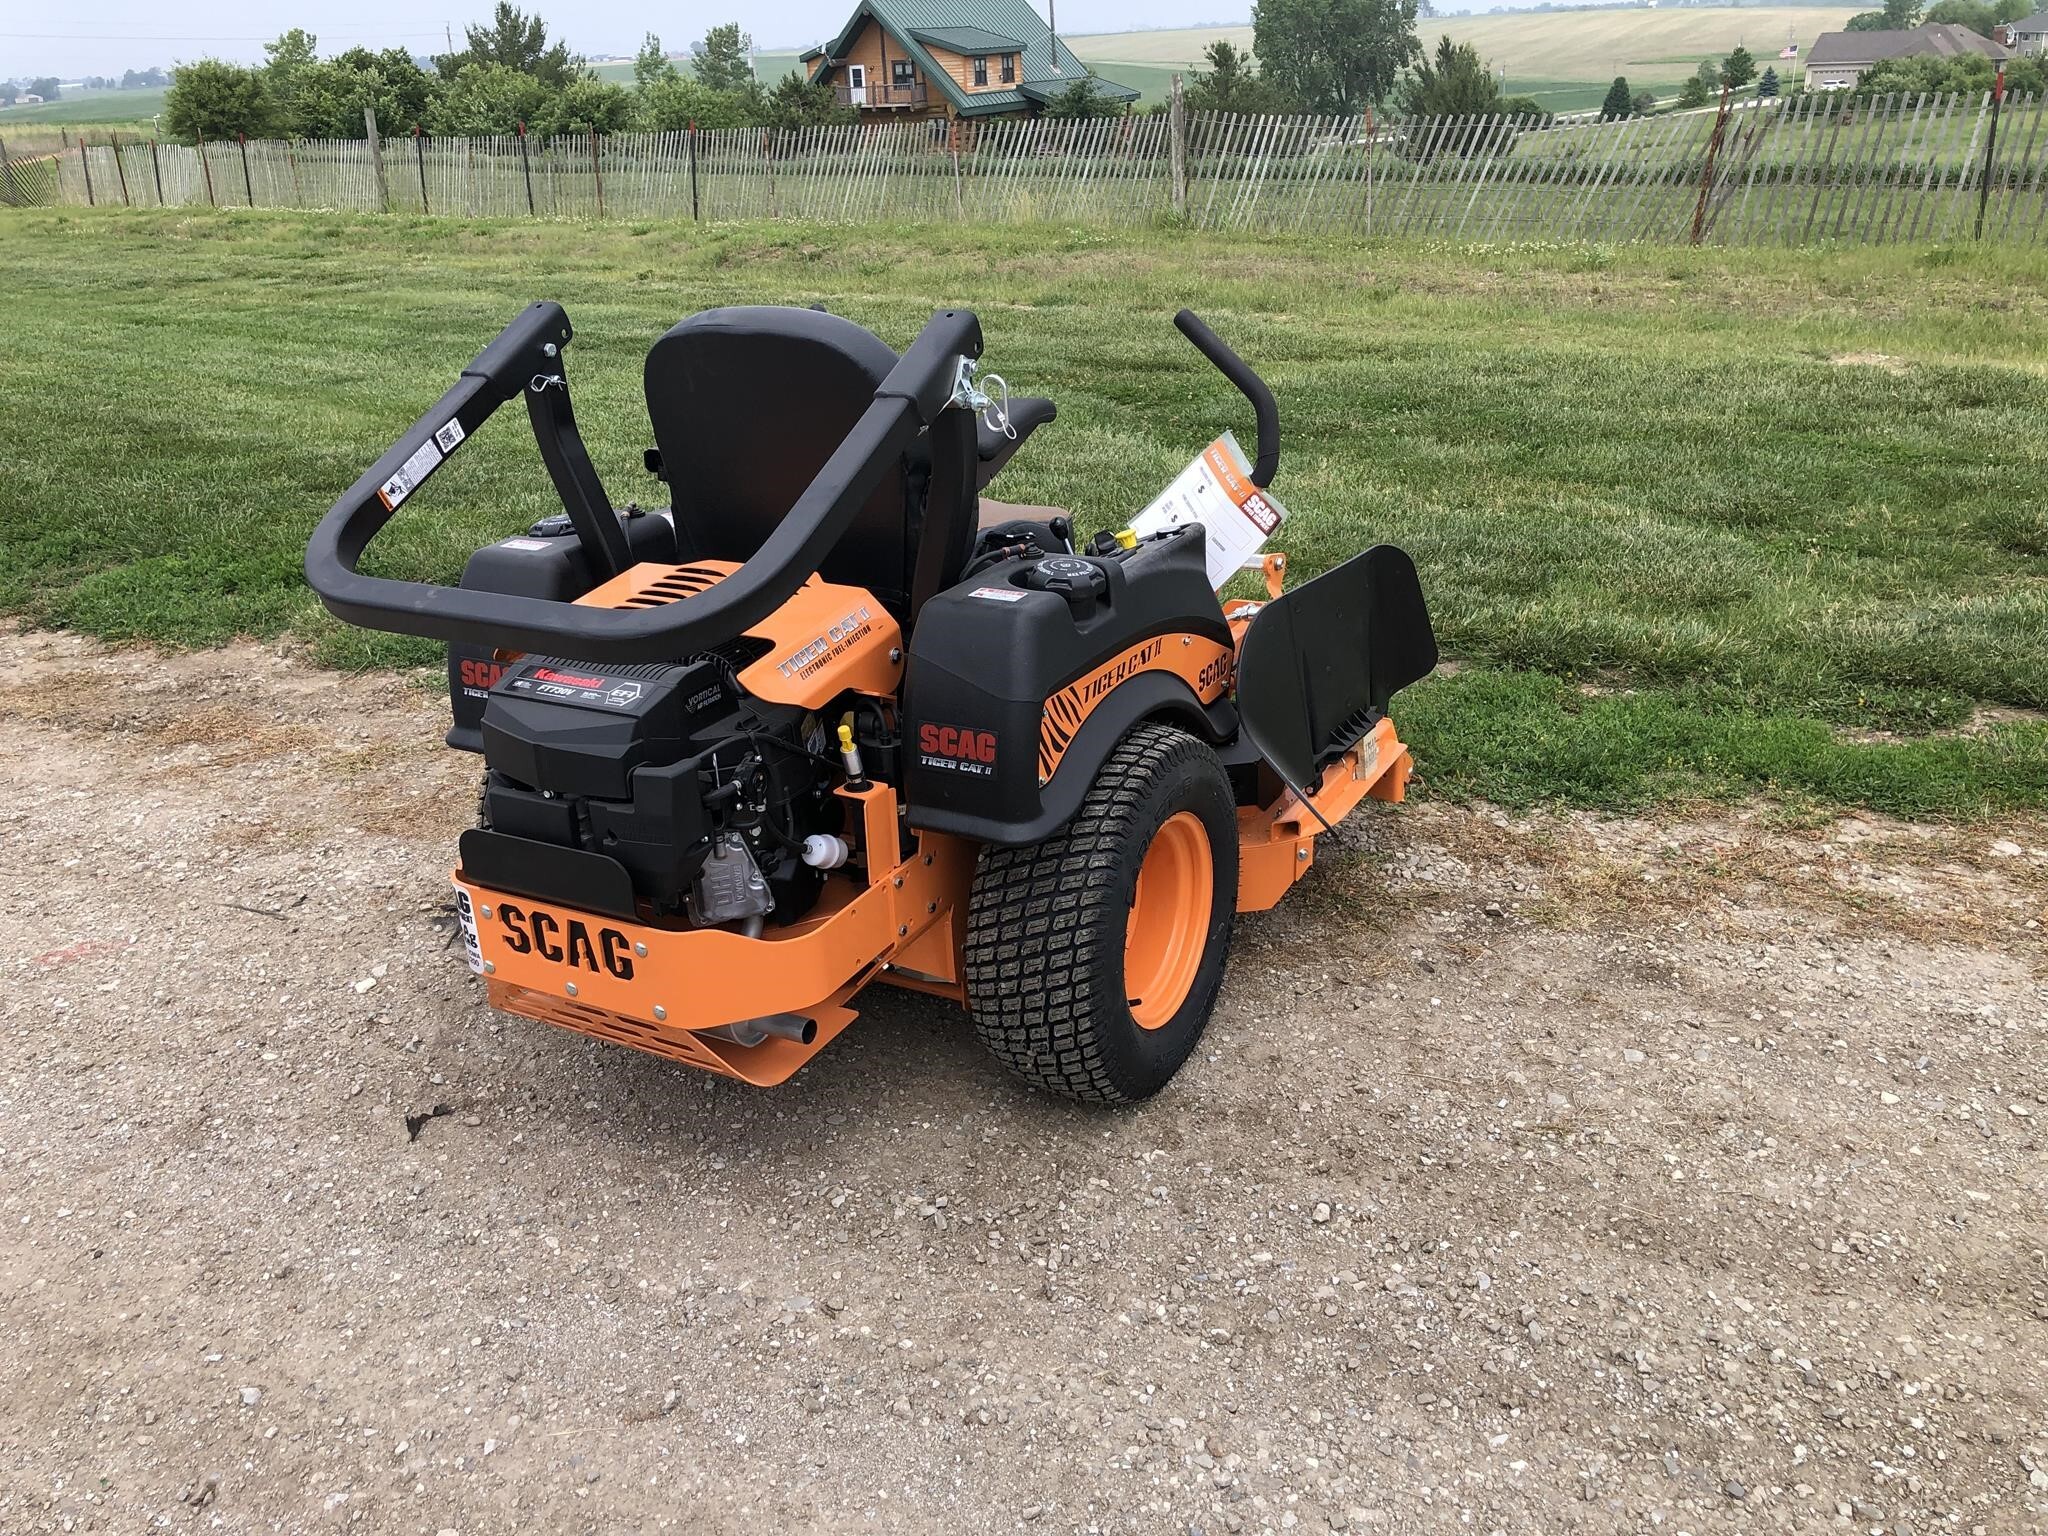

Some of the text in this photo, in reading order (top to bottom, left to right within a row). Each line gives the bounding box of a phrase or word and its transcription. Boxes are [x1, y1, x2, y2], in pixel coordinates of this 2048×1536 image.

[1246, 494, 1277, 527] SCAG
[776, 635, 829, 678] TIGER
[828, 612, 856, 643] CAT
[800, 624, 871, 680] ELECTRONIC FUEL-INJECTION
[460, 659, 509, 689] SCA
[533, 668, 605, 689] Kawasaki
[536, 684, 576, 696] FT730V
[1082, 661, 1126, 703] TIGER
[1128, 642, 1157, 674] CAT
[1198, 652, 1227, 692] SCAG
[463, 687, 489, 699] TIGER
[920, 724, 996, 763] SCAG
[920, 755, 957, 769] TIGER
[959, 762, 984, 775] CAT
[497, 903, 635, 981] SCAG
